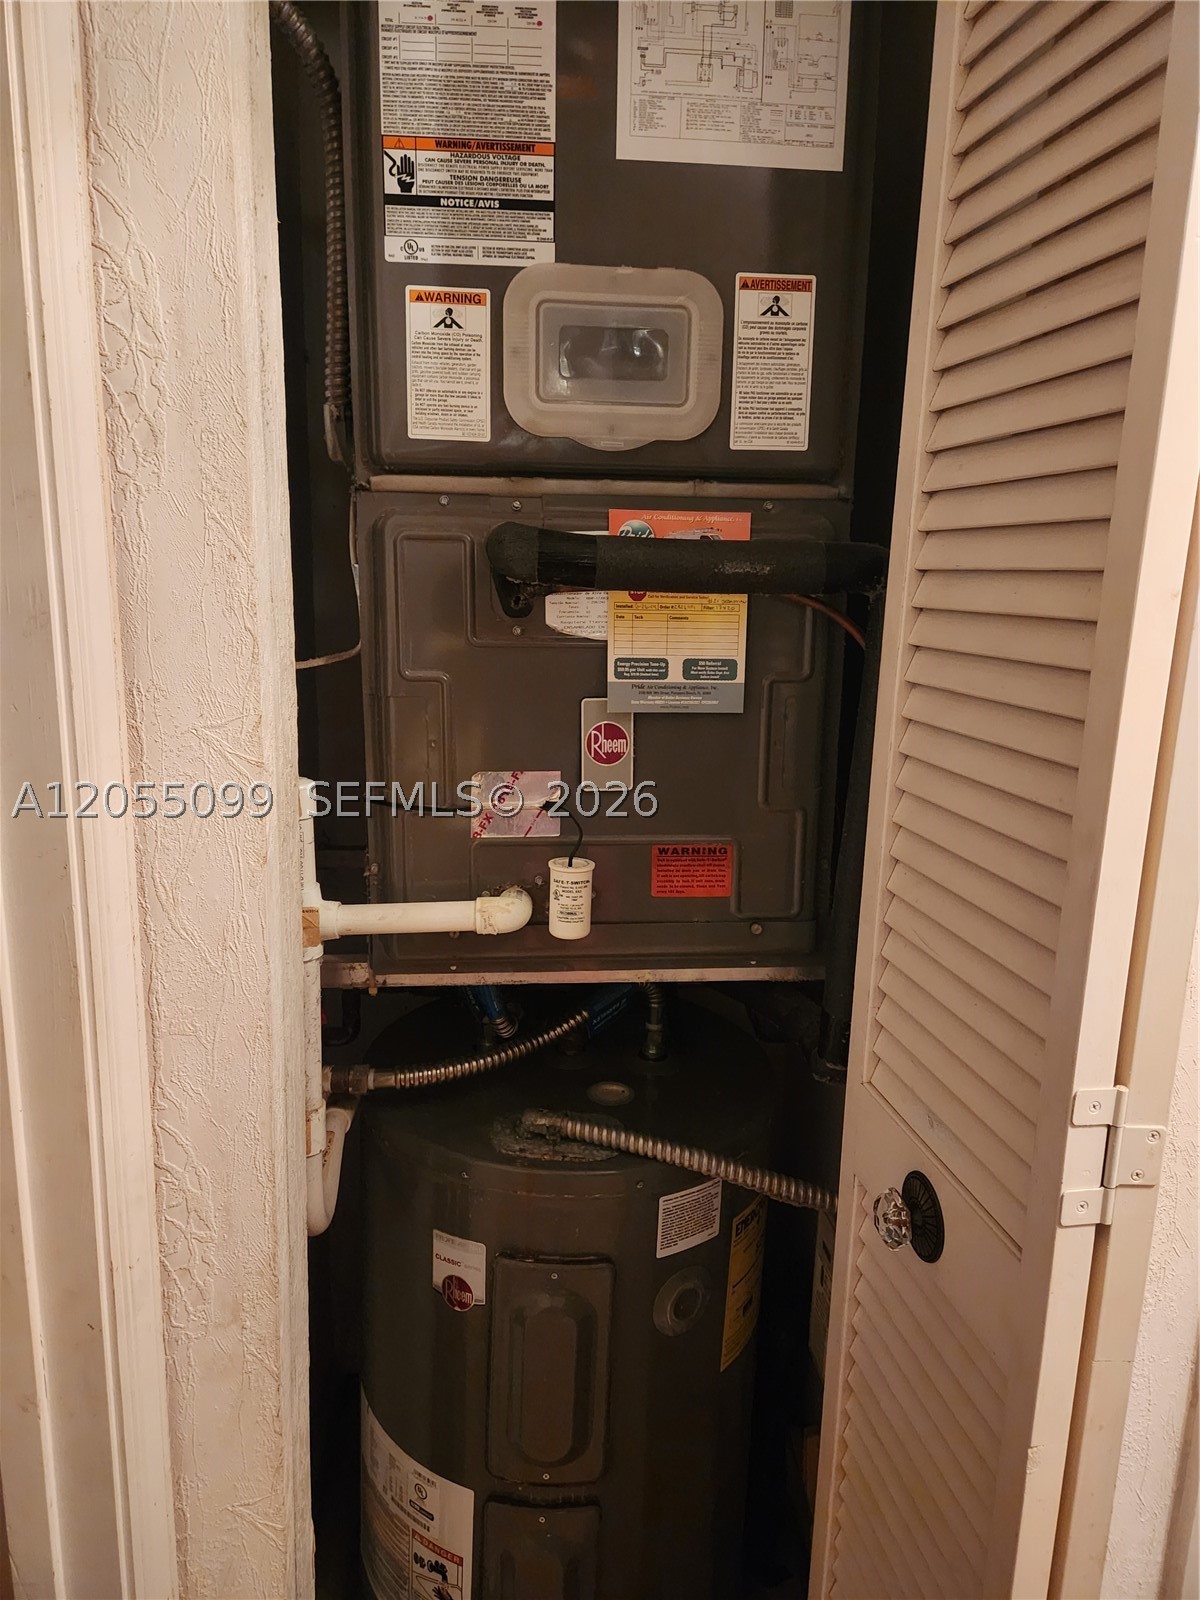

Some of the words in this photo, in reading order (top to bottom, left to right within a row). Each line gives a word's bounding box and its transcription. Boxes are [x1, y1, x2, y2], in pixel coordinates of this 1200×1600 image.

[434, 140, 536, 152] WARNING/AVERTISSEMENT
[450, 152, 490, 160] HAZARDOUS
[440, 198, 500, 208] NOTICE/AVIS
[750, 280, 812, 291] AVERTISSEMENT
[424, 292, 481, 304] WARNING
[653, 514, 694, 522] Conditioning
[591, 724, 626, 758] Rheem
[657, 847, 728, 855] WARNING
[435, 1253, 461, 1267] CLASSIC
[445, 1276, 472, 1305] Rheem
[424, 1540, 461, 1564] DANGER
